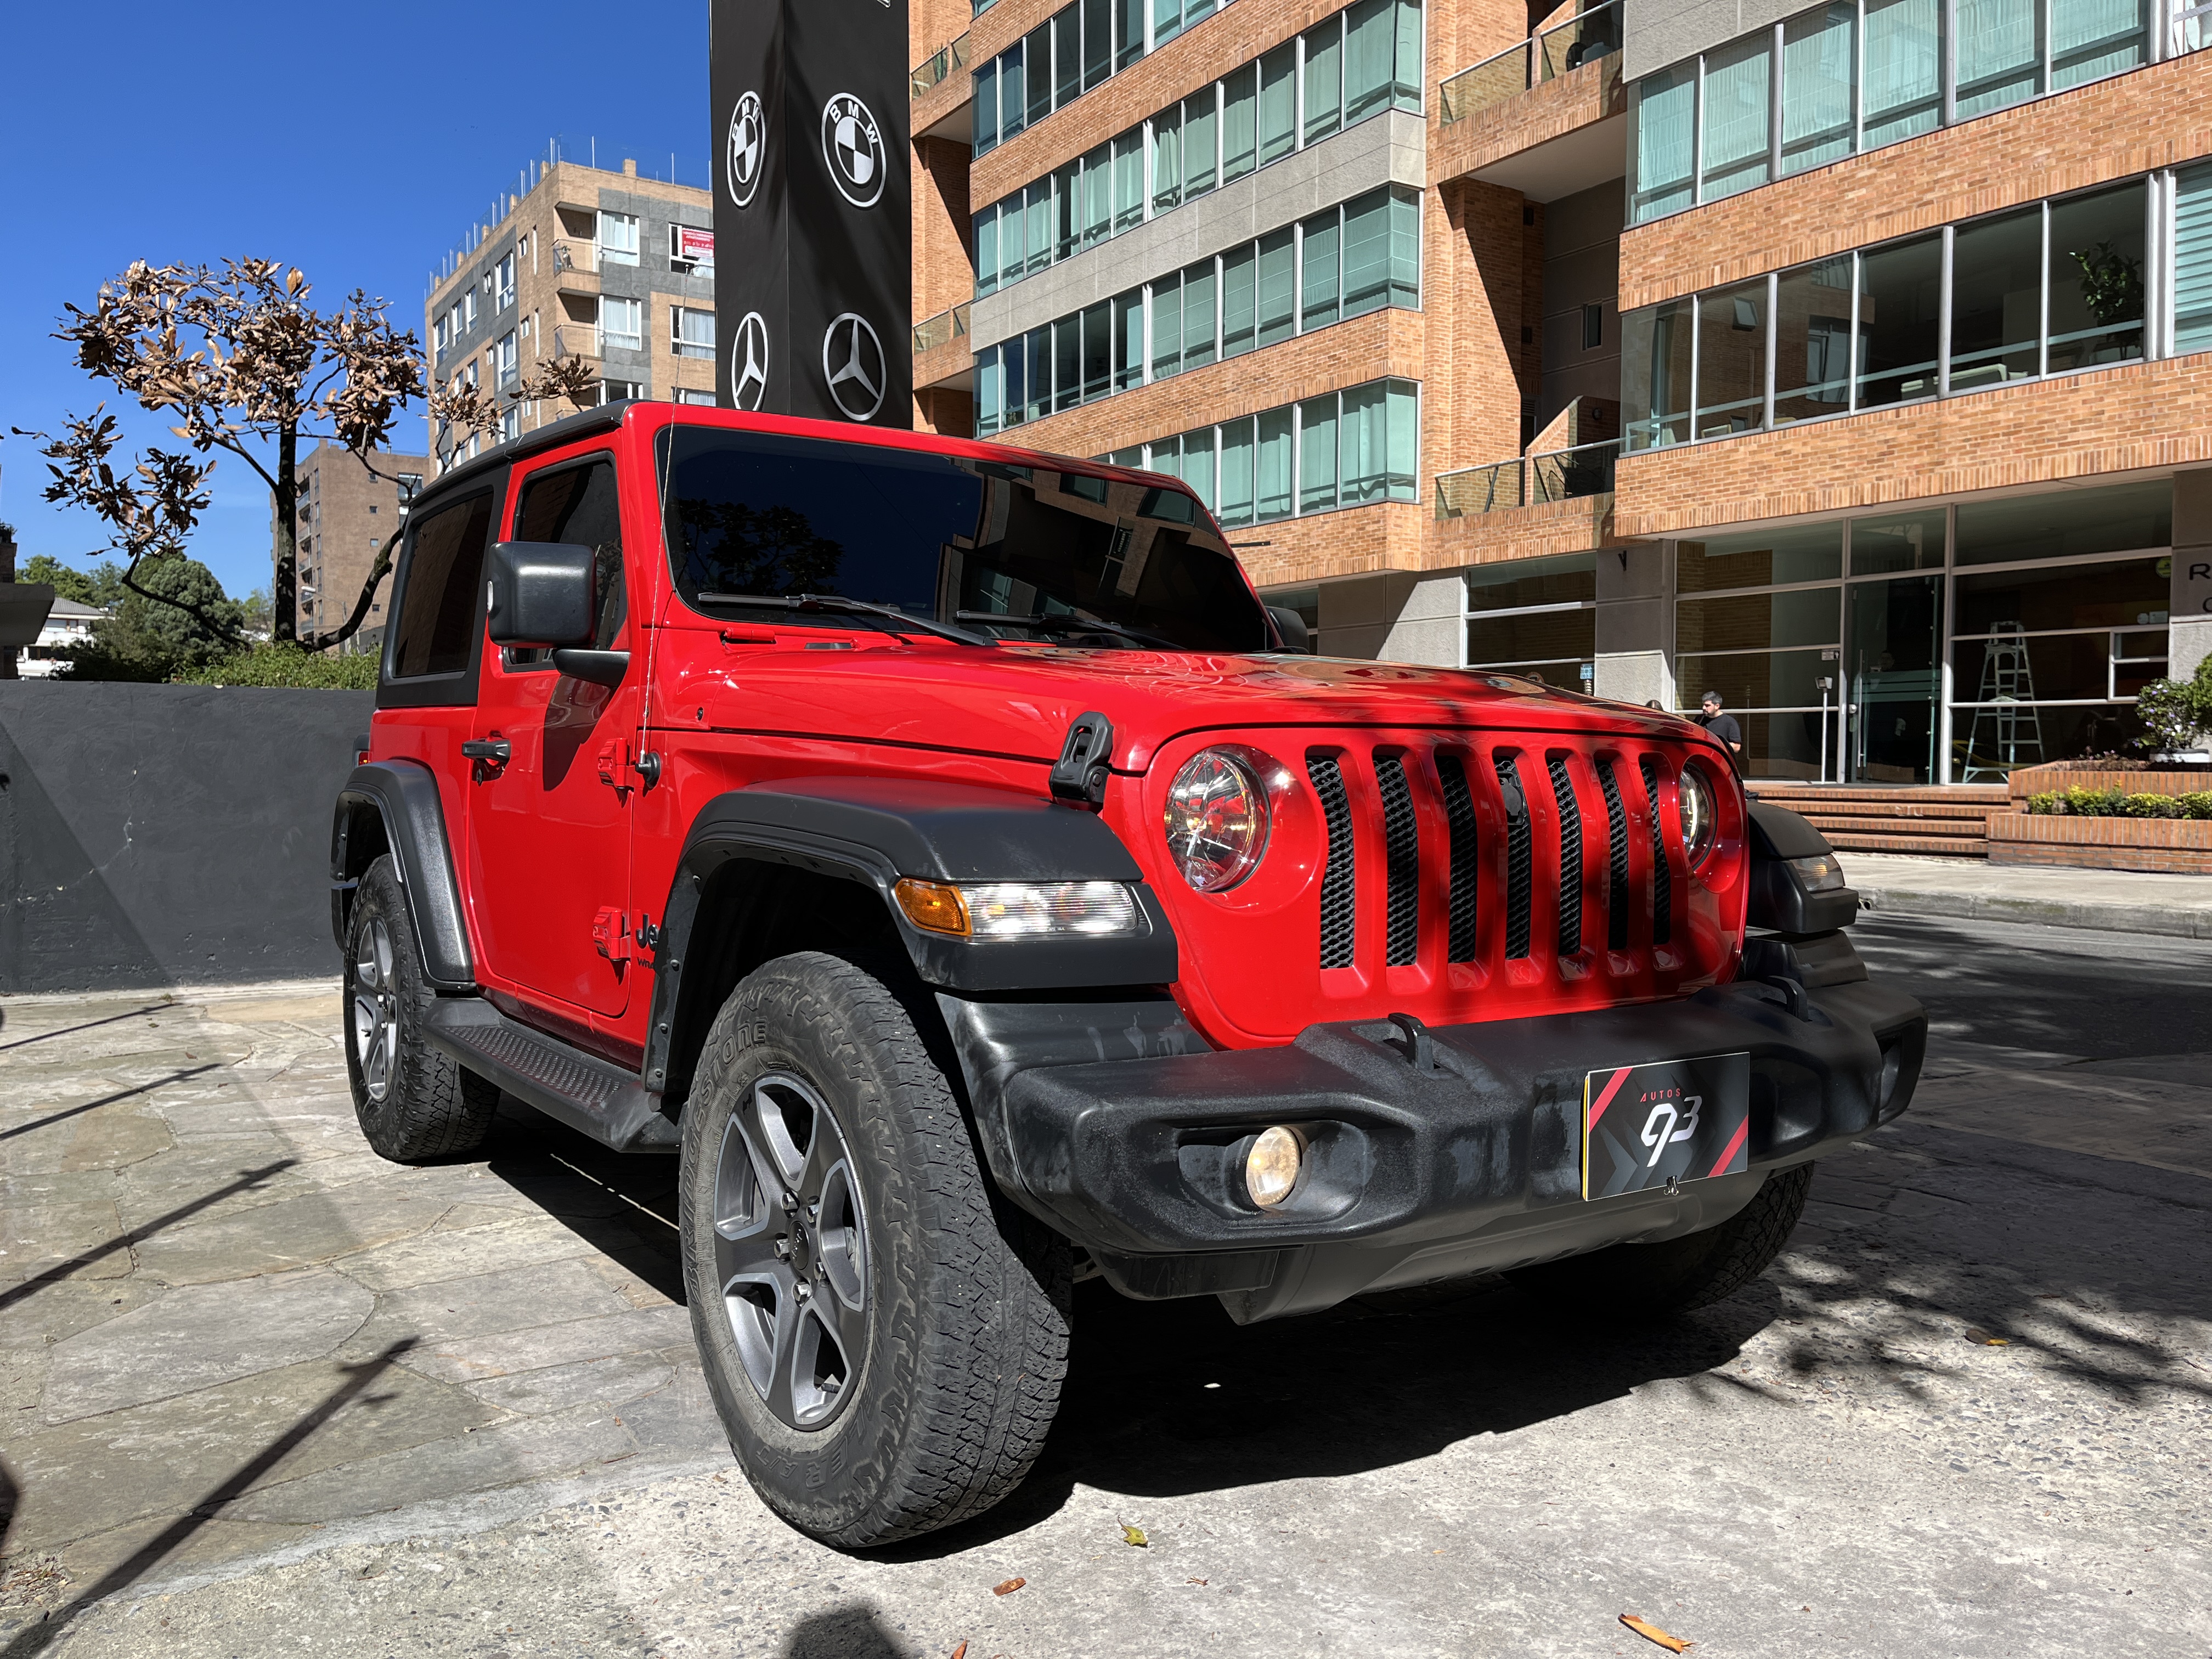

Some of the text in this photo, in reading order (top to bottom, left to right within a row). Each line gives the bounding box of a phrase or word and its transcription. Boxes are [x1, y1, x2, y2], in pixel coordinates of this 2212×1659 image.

[731, 99, 760, 142] BMW
[830, 100, 878, 144] BMW
[635, 913, 659, 952] Je
[1640, 1088, 1681, 1103] AUTOS
[1640, 1095, 1702, 1168] 93
